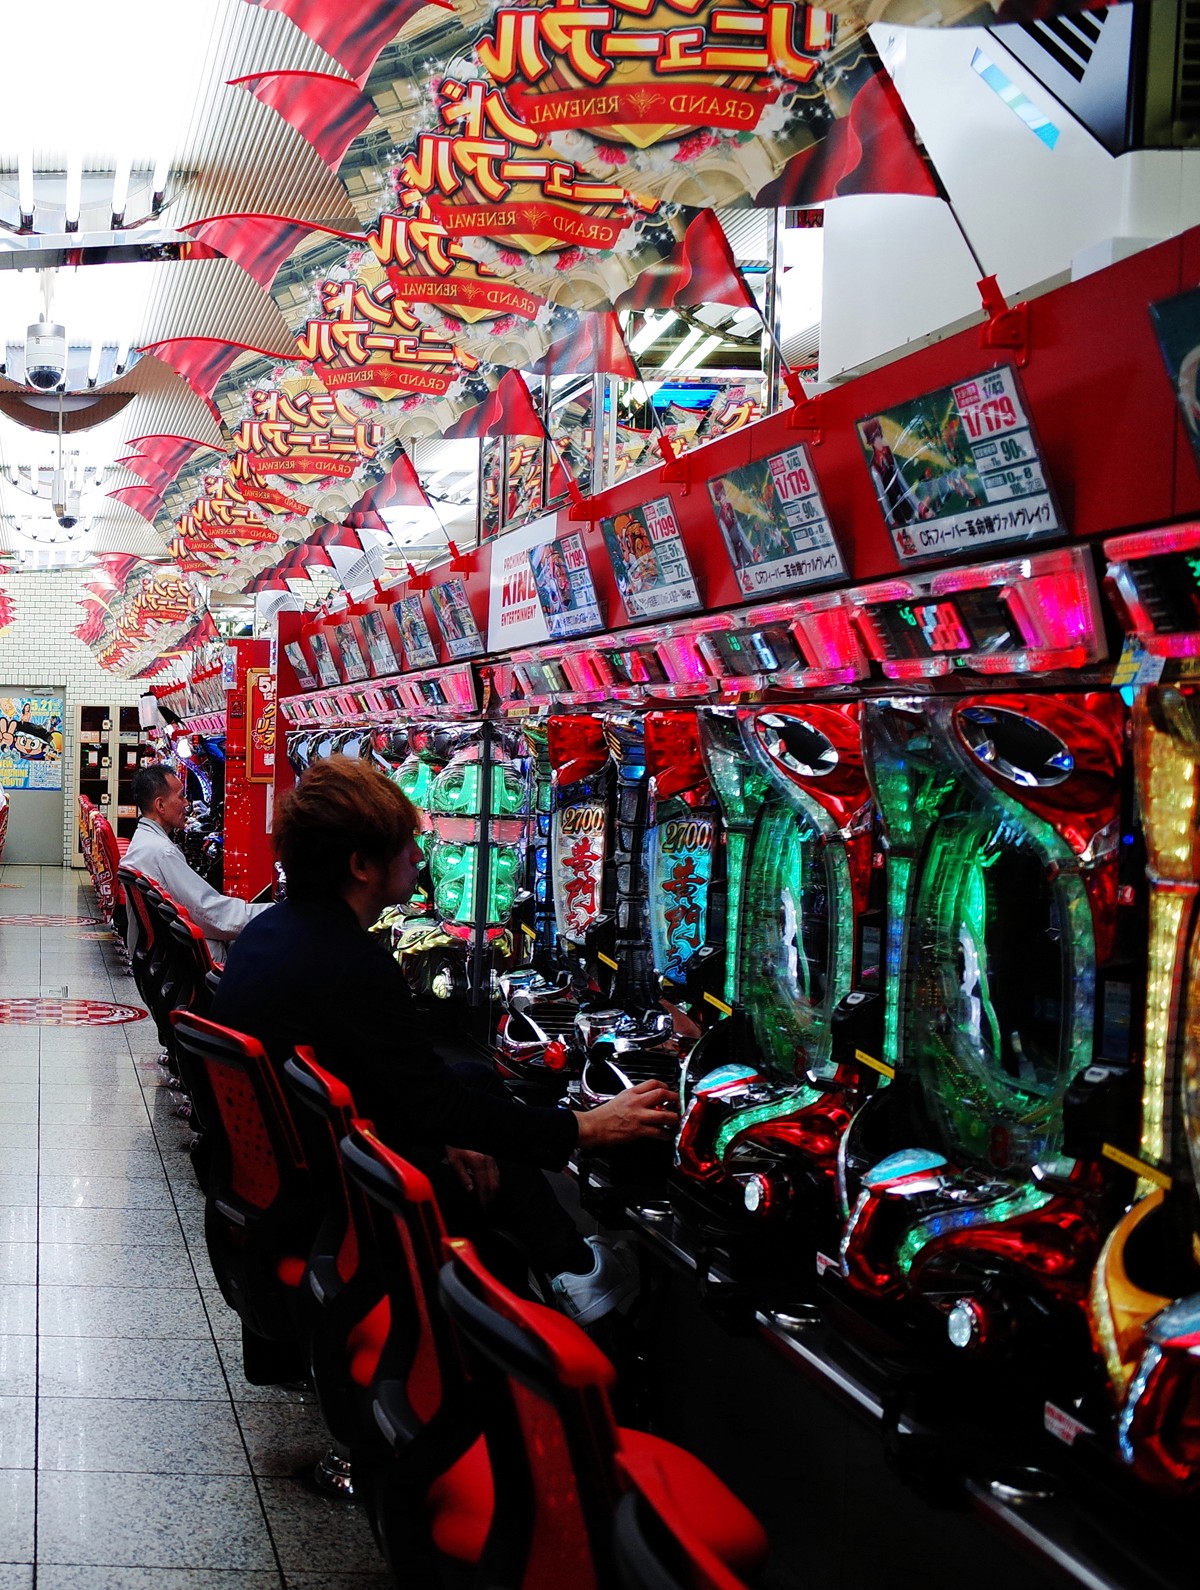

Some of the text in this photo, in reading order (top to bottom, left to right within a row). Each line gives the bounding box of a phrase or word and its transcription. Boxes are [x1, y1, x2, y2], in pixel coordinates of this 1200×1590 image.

[962, 395, 1017, 438] 1/179
[775, 468, 811, 500] 1/179
[648, 515, 677, 541] 1/199
[502, 568, 537, 608] KING
[31, 700, 53, 712] 5.21
[562, 806, 604, 835] 2700
[661, 820, 712, 854] 2700
